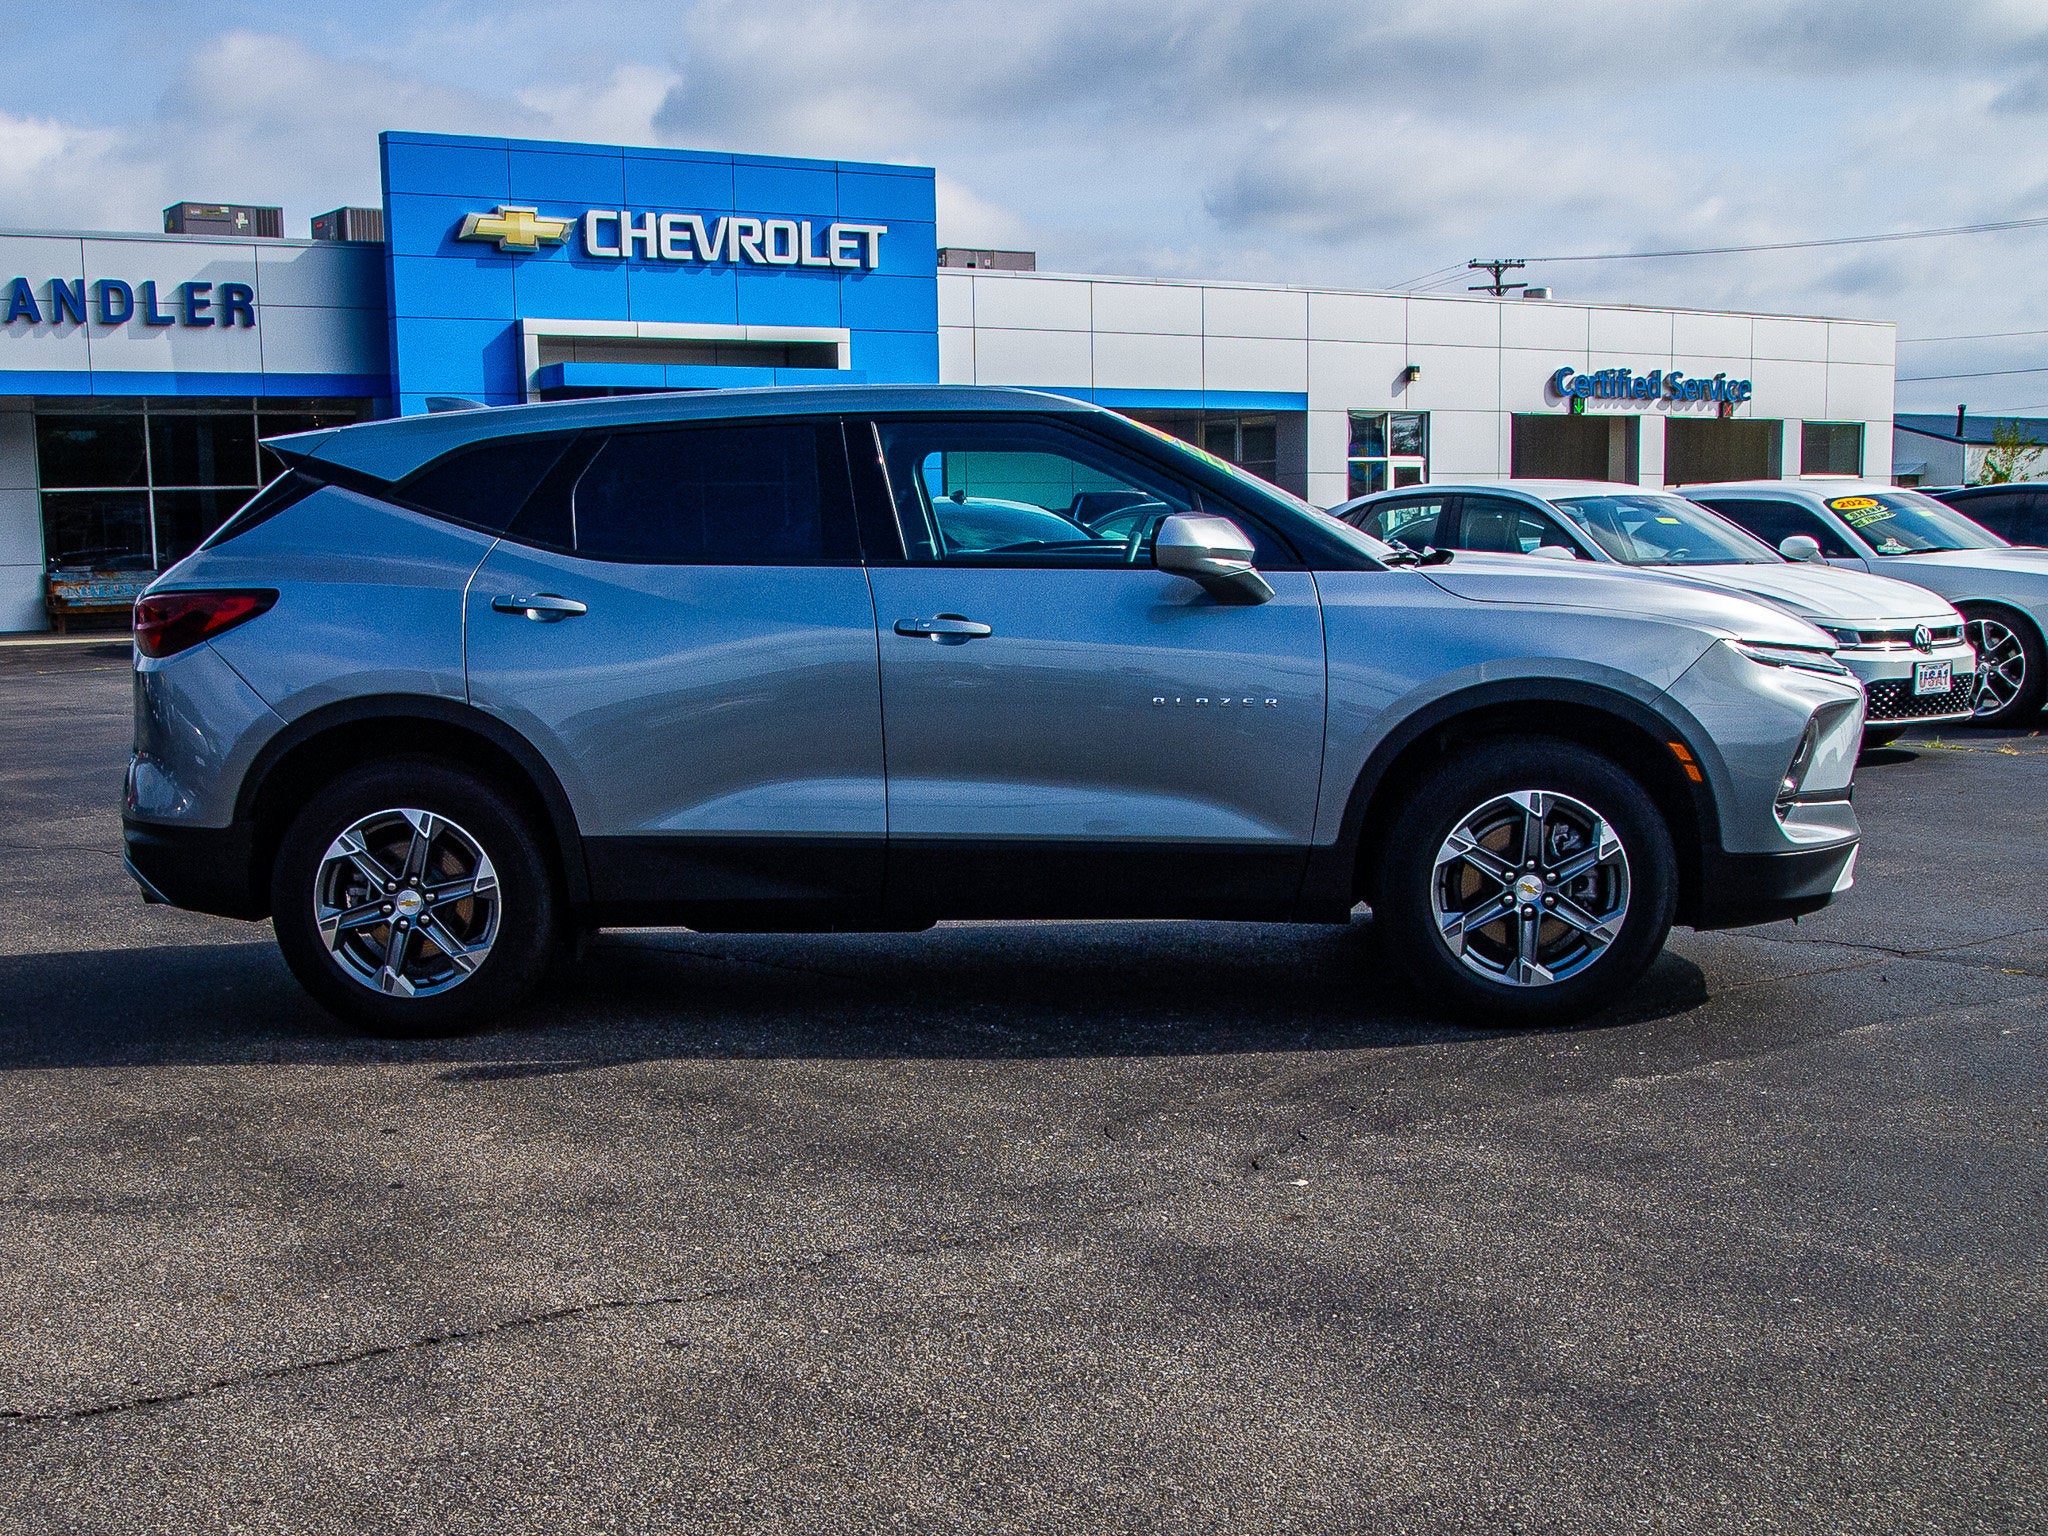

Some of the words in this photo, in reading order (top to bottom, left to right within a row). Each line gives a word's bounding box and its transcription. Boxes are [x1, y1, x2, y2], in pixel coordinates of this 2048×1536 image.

[584, 209, 889, 270] CHEVROLET
[4, 275, 256, 329] ANDLER
[1555, 366, 1662, 400] Certified
[1668, 371, 1752, 402] Service
[1837, 499, 1873, 508] 2023
[1919, 668, 1949, 688] USA1
[1152, 696, 1278, 708] BLAZER
